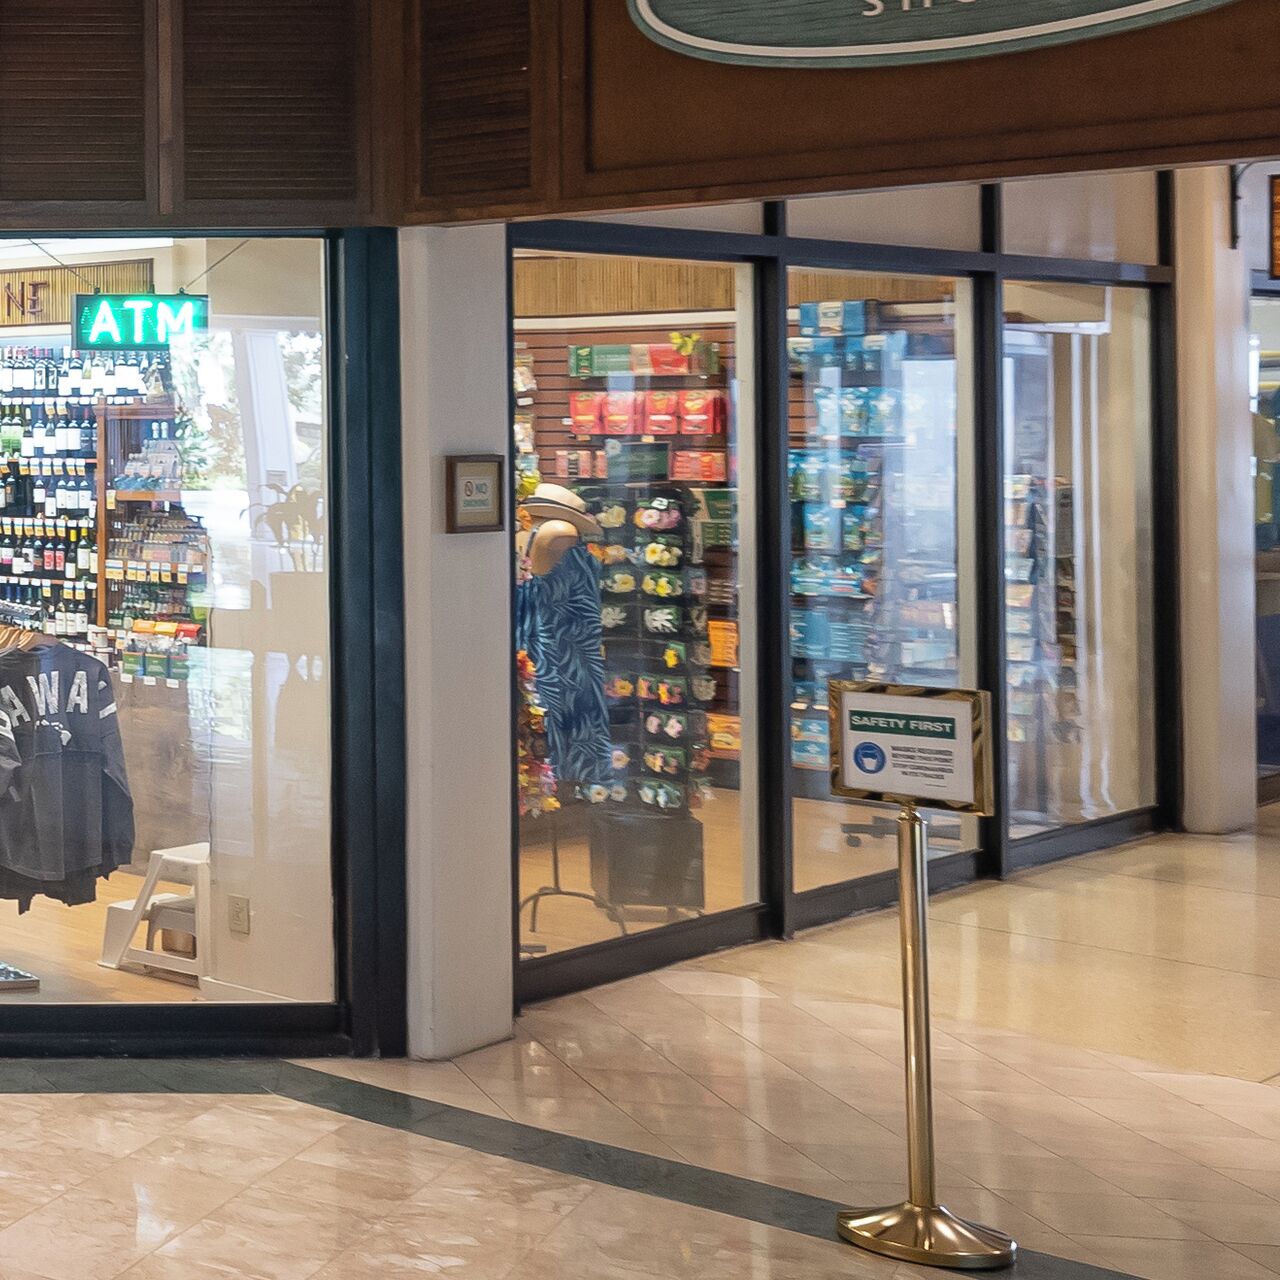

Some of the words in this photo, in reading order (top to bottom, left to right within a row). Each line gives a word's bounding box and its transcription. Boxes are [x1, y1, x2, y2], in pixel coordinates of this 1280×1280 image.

[87, 300, 195, 344] ATM
[851, 715, 906, 729] SAFETY
[909, 721, 953, 733] FIRST
